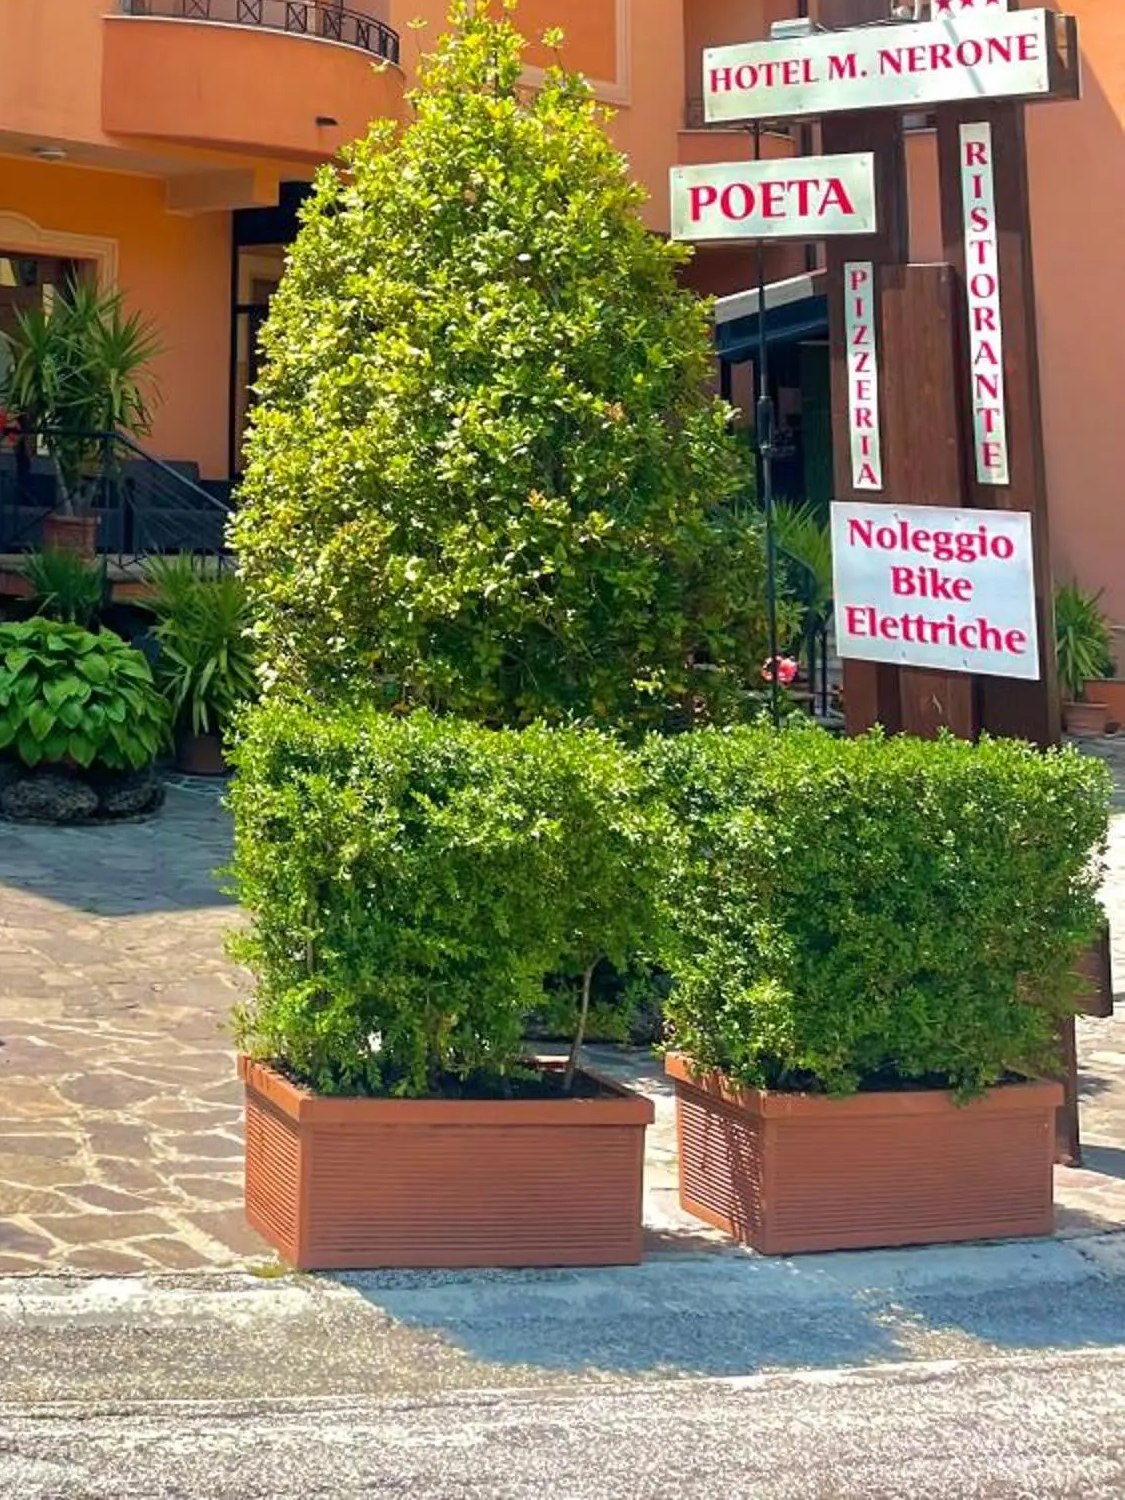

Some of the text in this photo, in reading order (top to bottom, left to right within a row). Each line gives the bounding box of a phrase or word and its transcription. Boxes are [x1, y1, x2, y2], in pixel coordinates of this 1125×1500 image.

[708, 33, 1039, 93] HOTEL M. NERONE
[688, 177, 855, 223] POETA
[964, 141, 1002, 469] RISTORANTE
[850, 270, 878, 485] PIZZERIA
[847, 518, 1015, 563] Noleggio
[890, 566, 973, 601] Bike
[845, 605, 1027, 654] Elettriche
